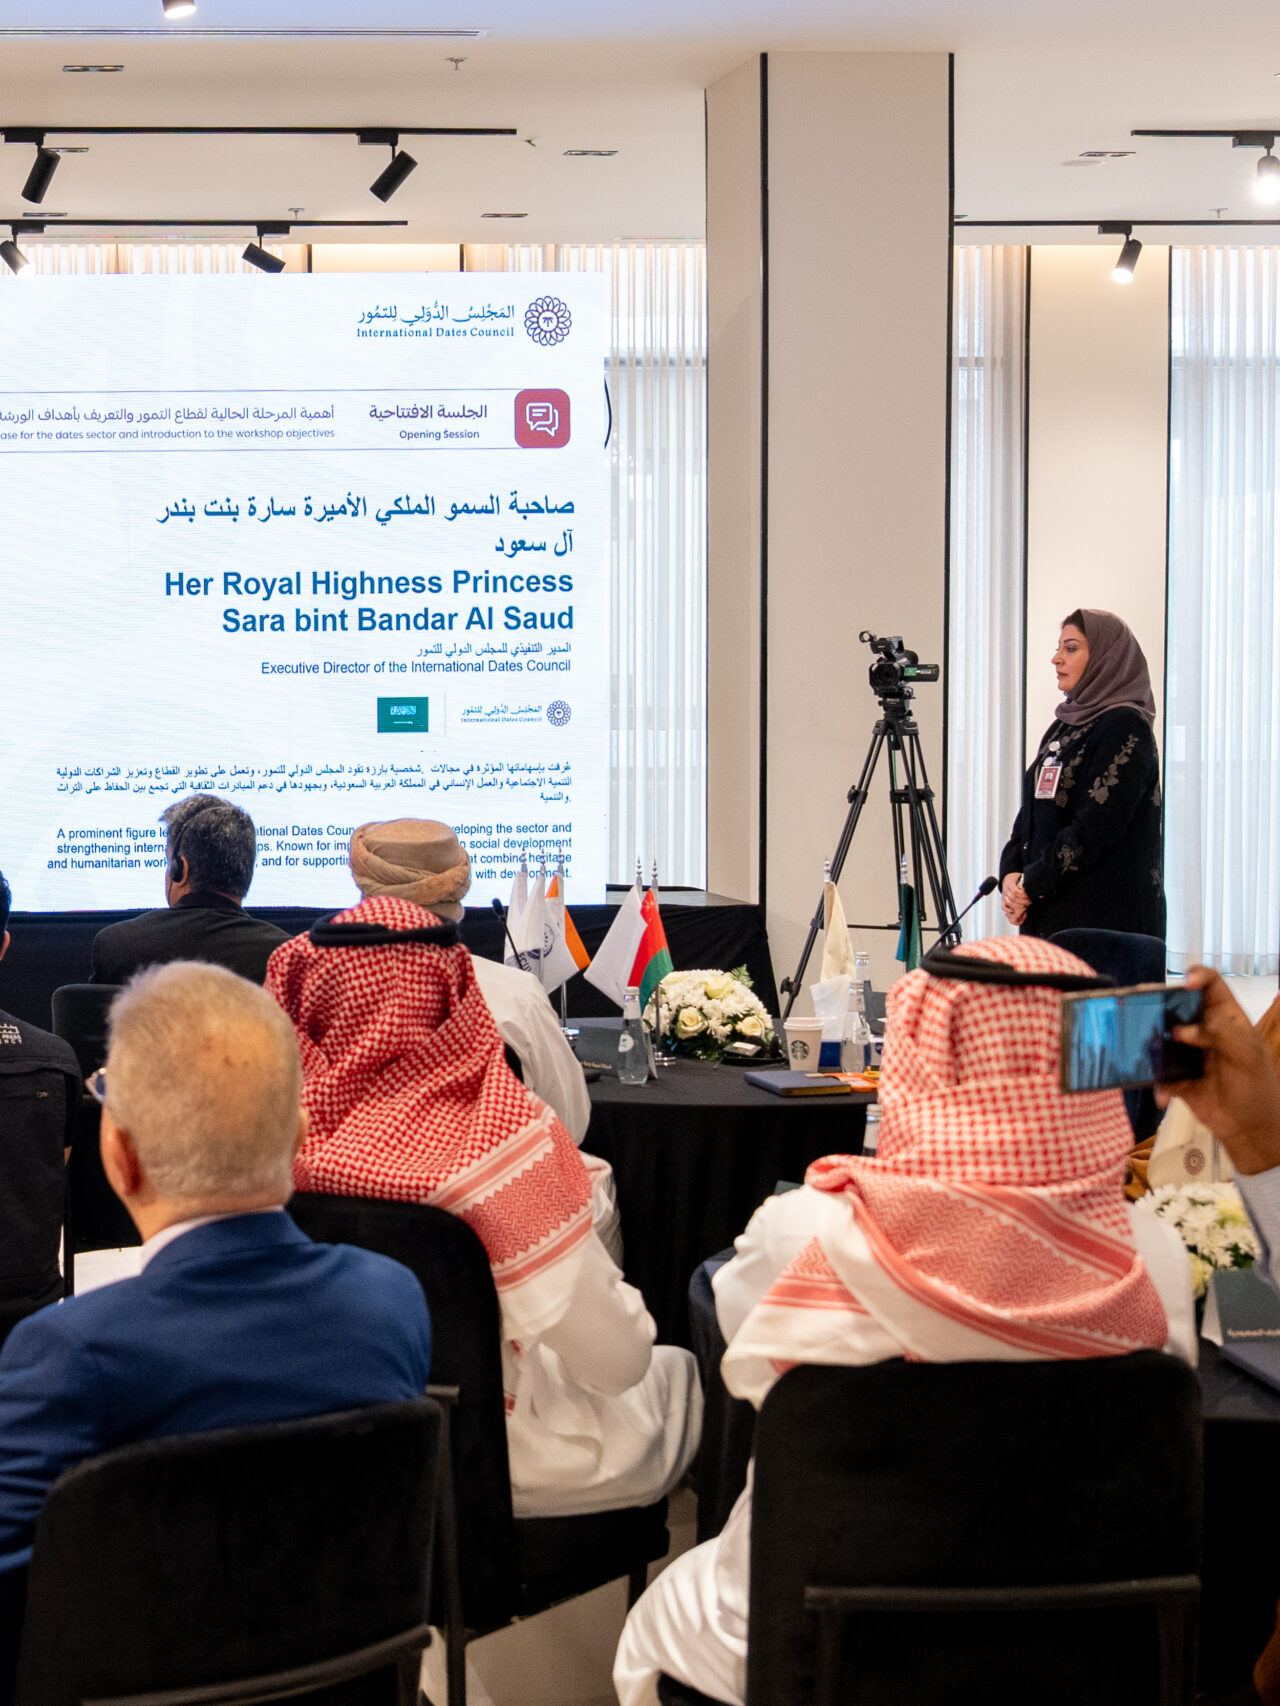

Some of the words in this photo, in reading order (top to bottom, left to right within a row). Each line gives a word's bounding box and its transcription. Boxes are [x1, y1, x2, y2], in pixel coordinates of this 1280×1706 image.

[356, 328, 433, 338] International
[436, 328, 467, 338] Dates
[470, 327, 515, 337] Council
[38, 406, 80, 422] بأهداف
[83, 407, 134, 424] والتعريف
[138, 407, 171, 424] التمور
[174, 407, 208, 424] لقطاع
[211, 407, 249, 423] الحالية
[252, 406, 297, 423] المرحلة
[300, 405, 335, 422] أهمية
[369, 403, 434, 422] الافتتاحية
[437, 404, 488, 421] الجلسة
[20, 430, 35, 440] for
[37, 431, 53, 440] the
[55, 430, 84, 440] dates
[86, 430, 116, 440] sector
[118, 429, 139, 439] and
[141, 429, 202, 439] introduction
[204, 429, 215, 438] to
[217, 429, 233, 438] the
[236, 428, 283, 440] workshop
[286, 428, 335, 440] objectives
[399, 430, 441, 441] Opening
[443, 429, 480, 439] Session
[156, 499, 196, 524] بندر
[204, 497, 240, 521] بنت
[248, 494, 296, 523] سارة
[304, 492, 367, 523] الأميرة
[375, 494, 435, 526] الملكي
[445, 493, 500, 521] السمو
[508, 491, 575, 518] صاحبة
[495, 536, 547, 558] سعود
[553, 529, 574, 556] آل
[165, 572, 214, 596] Her
[223, 571, 301, 601] Royal
[312, 570, 443, 601] Highness
[453, 570, 574, 594] Princess
[222, 608, 286, 633] Sara
[295, 607, 349, 632] bint
[358, 607, 459, 632] Bandar
[465, 606, 494, 631] Al
[504, 606, 574, 631] Saud
[416, 643, 443, 658] للتمور
[445, 643, 473, 658] الدولي
[475, 642, 508, 657] للمجلس
[510, 642, 543, 658] التنفيذي
[547, 641, 572, 656] المدير
[261, 661, 320, 675] Executive
[323, 661, 371, 675] Director
[374, 660, 386, 674] of
[389, 660, 408, 674] the
[412, 659, 484, 673] International
[488, 659, 524, 673] Dates
[527, 659, 572, 672] Council
[56, 766, 82, 779] الدولية
[84, 766, 121, 779] الشراكات
[126, 767, 153, 779] وتعزيز
[154, 766, 181, 779] القطاع
[184, 765, 208, 778] تطوير
[210, 765, 226, 778] على
[230, 765, 255, 777] وتعمل
[288, 764, 313, 778] الدولي
[315, 764, 345, 776] المجلس
[348, 764, 364, 777] تقود
[366, 764, 388, 776] بارزة
[431, 763, 461, 775] مجالات
[463, 764, 474, 776] في
[85, 781, 101, 795] على
[104, 781, 130, 792] الحفاظ
[132, 782, 146, 794] بين
[148, 782, 169, 795] تجمع
[171, 780, 187, 794] التي
[218, 780, 255, 793] المبادرات
[257, 781, 274, 792] دعم
[276, 781, 287, 793] في
[370, 778, 397, 791] العربية
[399, 778, 426, 789] المملكة
[429, 779, 440, 791] في
[477, 777, 504, 790] والعمل
[548, 776, 572, 789] التنمية
[57, 829, 66, 839] A
[68, 827, 123, 842] prominent
[125, 827, 157, 842] figure
[292, 826, 324, 838] Dates
[327, 824, 355, 837] Coun
[453, 824, 493, 838] eloping
[495, 823, 513, 835] the
[516, 823, 549, 835] sector
[552, 821, 572, 834] and
[57, 842, 131, 857] strengthening
[276, 840, 314, 853] Known
[316, 839, 332, 852] for
[469, 839, 500, 850] social
[503, 837, 573, 852] development
[47, 857, 68, 869] and
[71, 856, 141, 869] humanitarian
[261, 855, 283, 867] and
[285, 854, 300, 867] for
[302, 854, 350, 869] supporti
[475, 868, 497, 880] with
